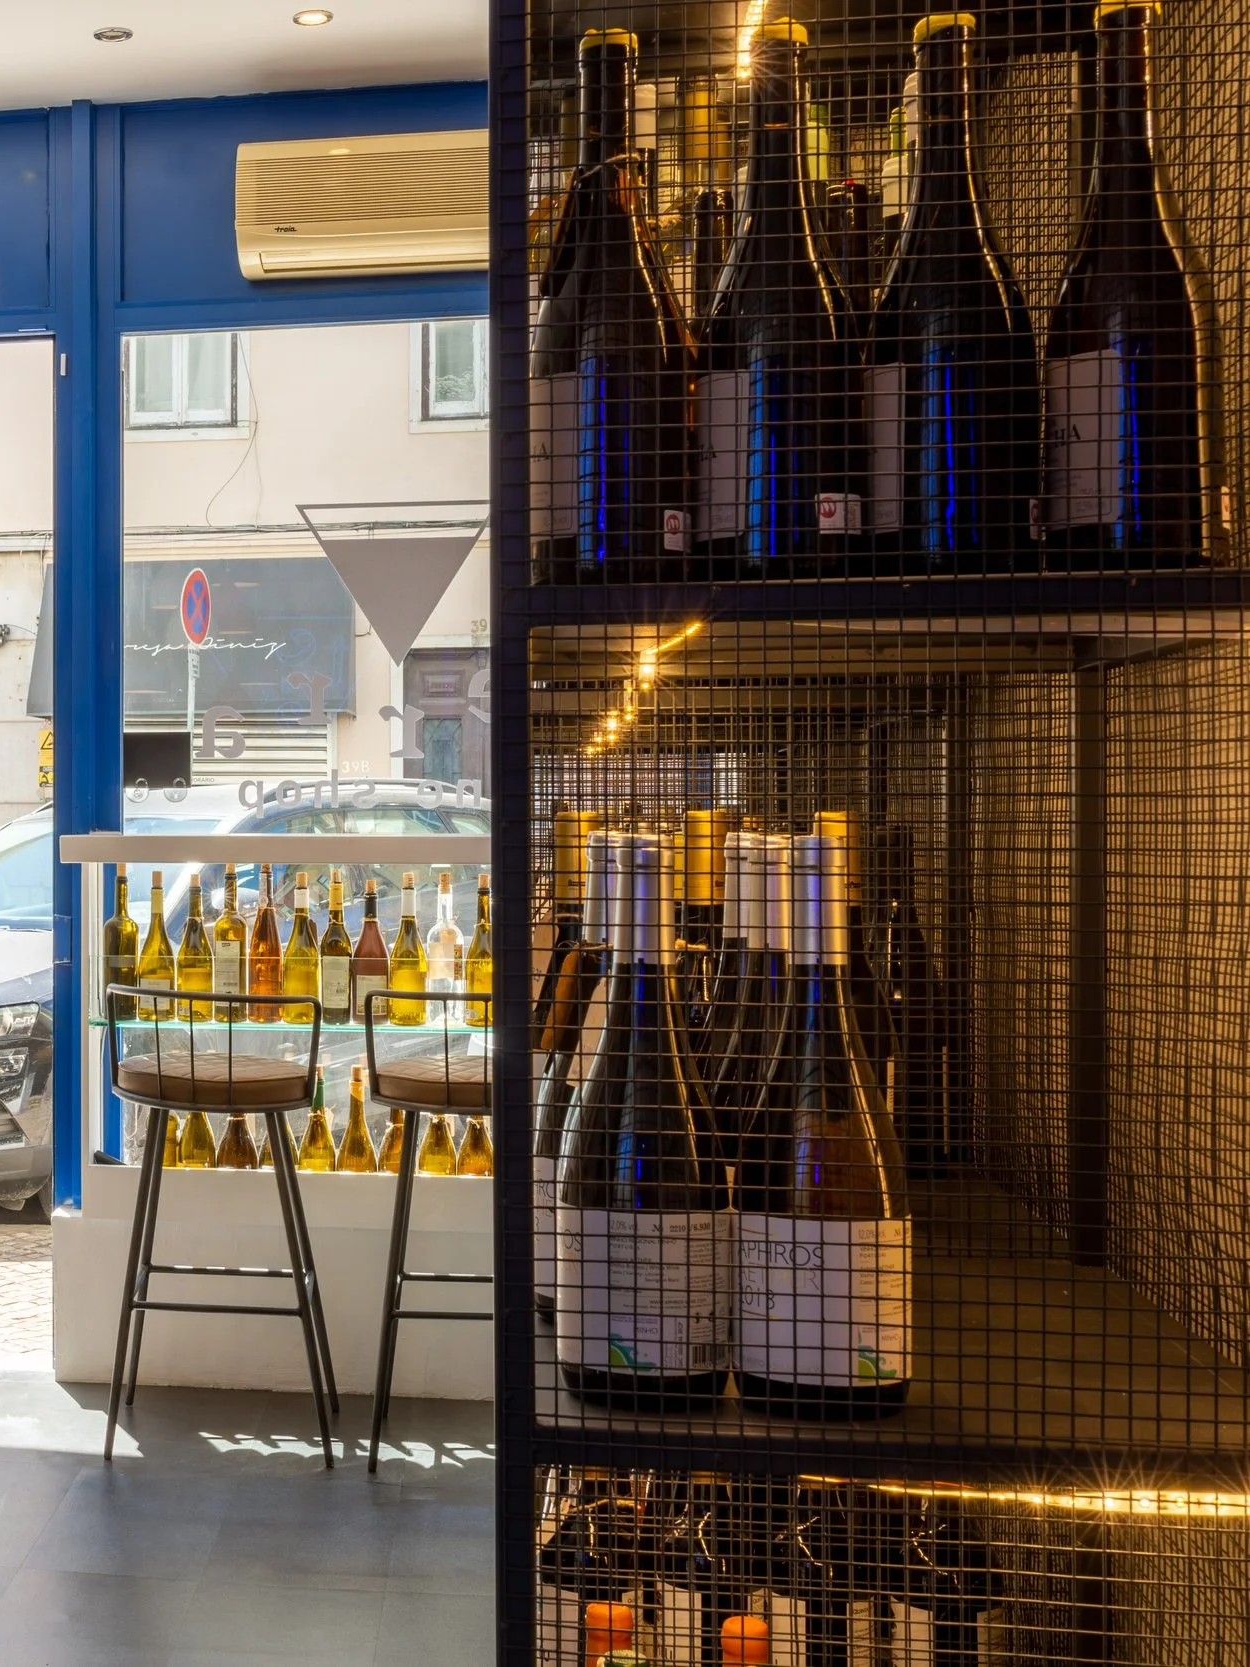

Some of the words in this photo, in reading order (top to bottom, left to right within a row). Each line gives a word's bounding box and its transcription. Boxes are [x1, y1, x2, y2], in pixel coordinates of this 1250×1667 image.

[470, 618, 488, 634] 39
[341, 760, 370, 774] 39B
[737, 1241, 825, 1268] APHROS
